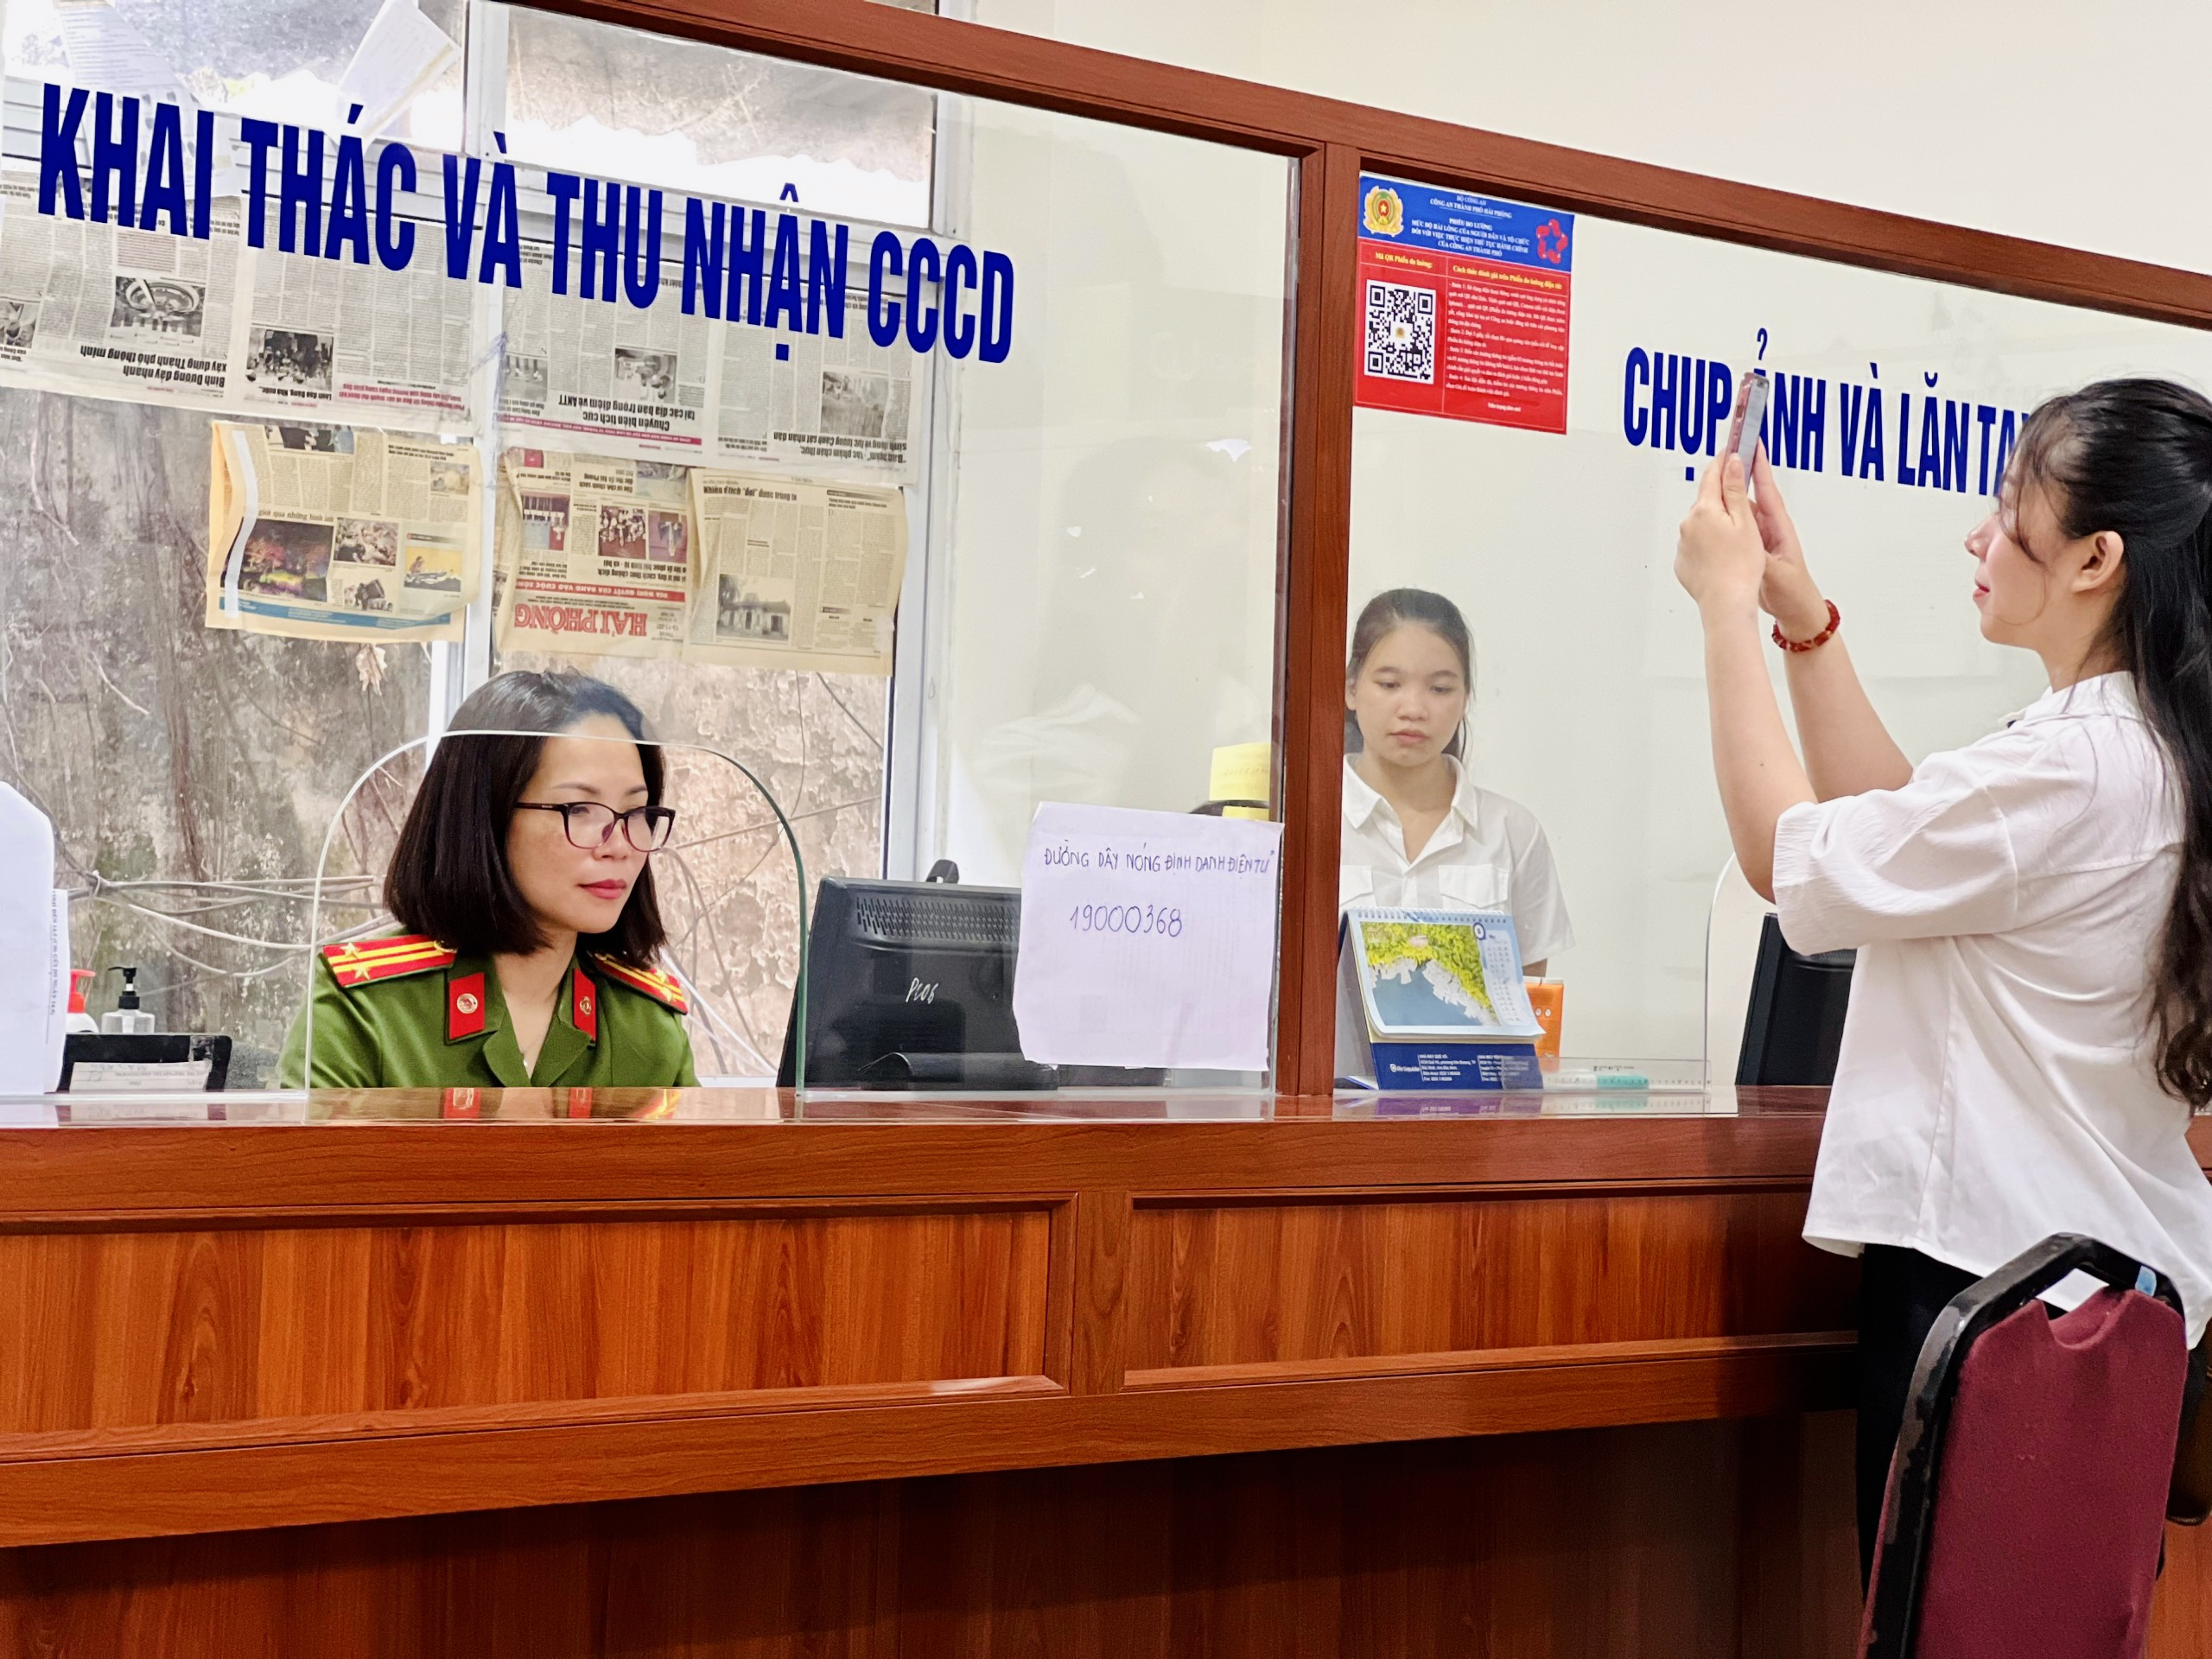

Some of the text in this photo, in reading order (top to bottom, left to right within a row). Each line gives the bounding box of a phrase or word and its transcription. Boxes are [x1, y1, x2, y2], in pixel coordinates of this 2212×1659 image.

[39, 83, 1014, 364] KHAI THÁC VÀ THU NHẬN CCCD
[79, 345, 106, 359] minh
[123, 365, 154, 378] nhanh
[204, 375, 226, 388] Bình
[558, 394, 577, 408] ANTT
[600, 414, 616, 425] tích
[1624, 346, 1732, 481] CHỤP
[1840, 363, 1885, 481] VÀ
[1897, 372, 1970, 493] LĂN
[1977, 404, 2030, 496] TA
[514, 603, 599, 634] PHÒNG
[600, 610, 648, 637] HẢI
[1044, 838, 1090, 868] ĐƯỜNG
[1097, 848, 1119, 871] DÂY
[1126, 842, 1160, 873] NÓNG
[1164, 853, 1192, 874] ĐỊNH
[1195, 856, 1225, 873] DANH
[1070, 904, 1183, 938] 19000368
